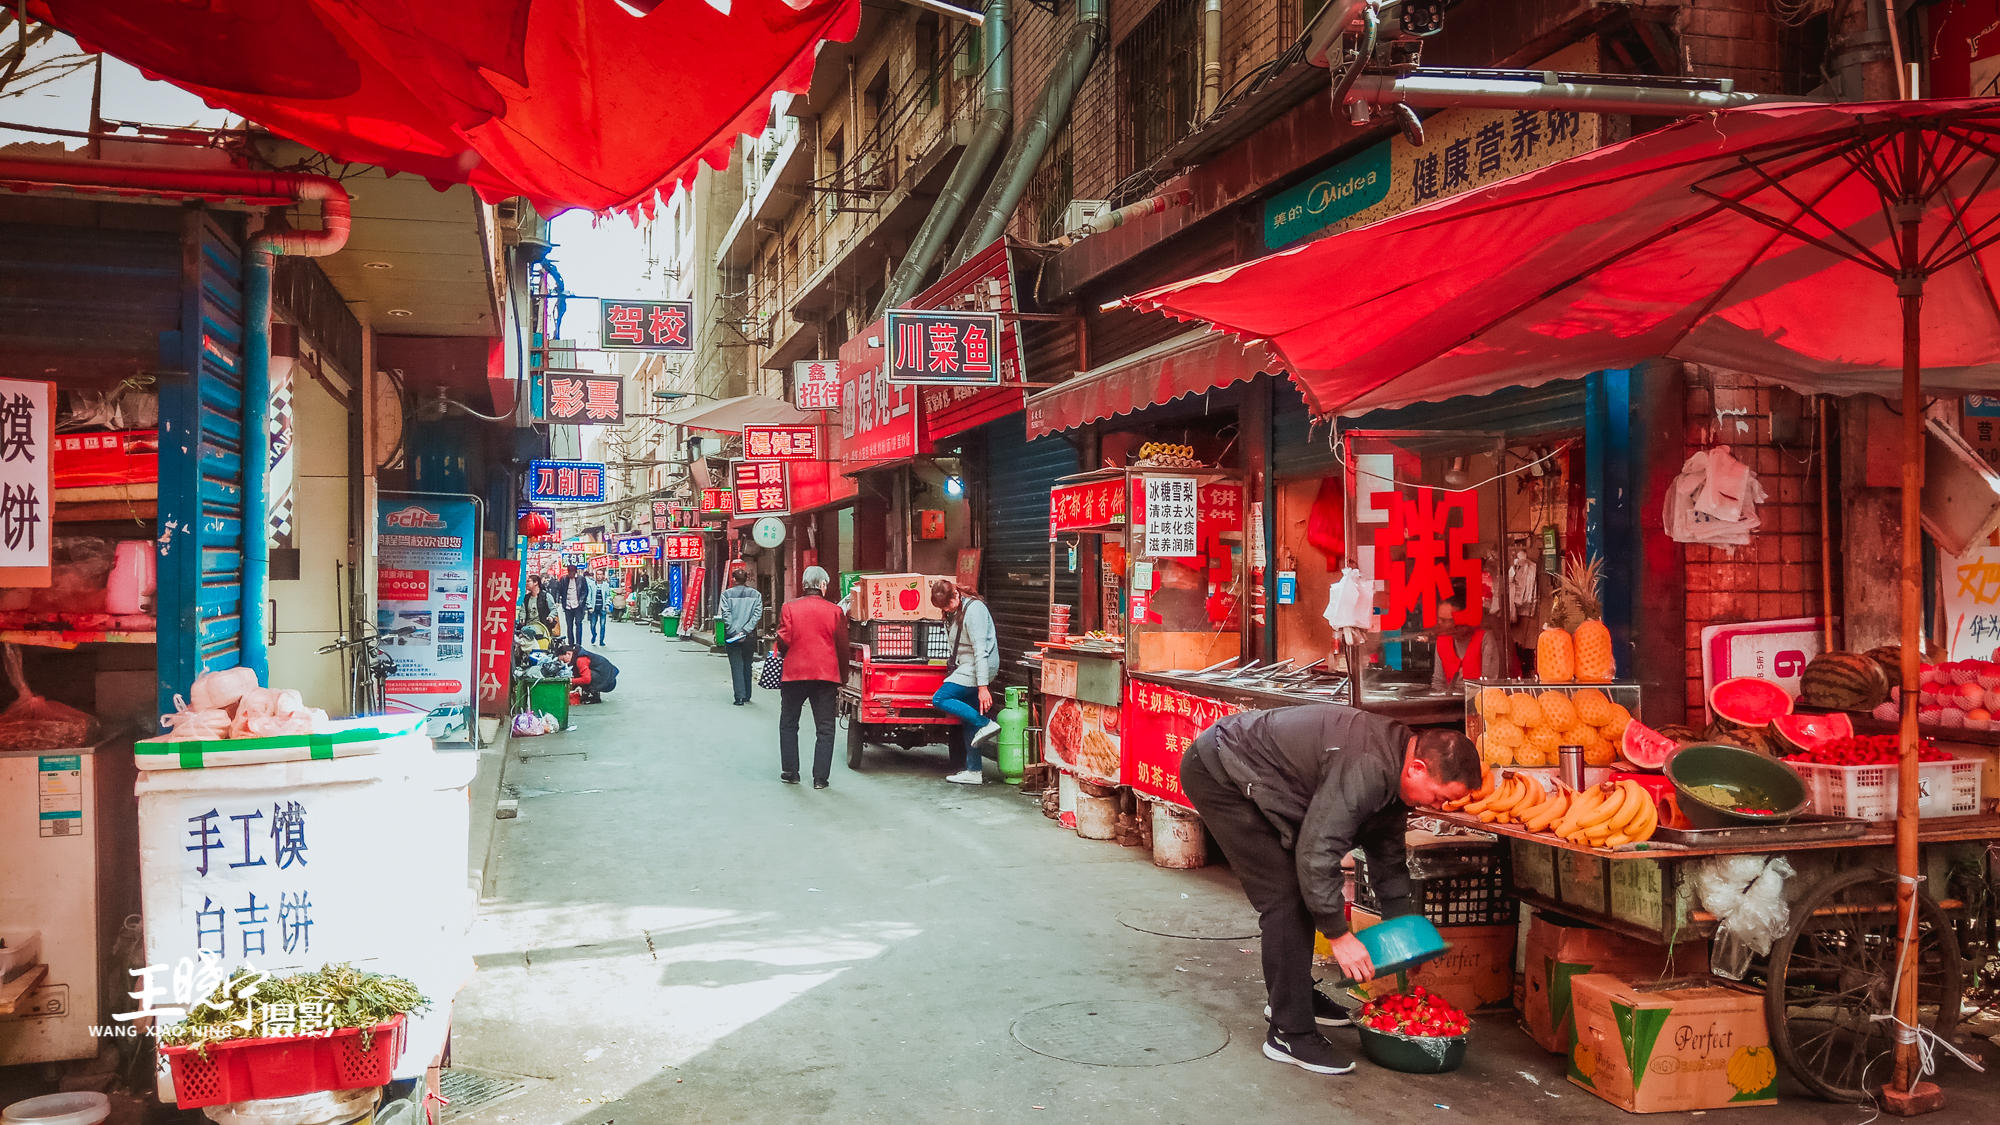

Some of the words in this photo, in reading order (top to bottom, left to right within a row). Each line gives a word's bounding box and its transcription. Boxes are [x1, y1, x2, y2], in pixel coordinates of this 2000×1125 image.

[1411, 108, 1580, 204] 健康营养粥
[1319, 170, 1378, 206] Midea
[1273, 203, 1304, 230] 美的
[608, 304, 687, 345] 驾校
[895, 322, 992, 374] 川菜鱼
[550, 378, 620, 420] 彩票
[749, 431, 813, 456] 馄饨王
[536, 467, 601, 498] 刀削面
[736, 463, 783, 485] 三顾
[1149, 481, 1194, 503] 冰糖雪梨
[738, 487, 783, 510] 冒菜
[1149, 504, 1195, 518] 清凉去火
[0, 482, 41, 553] 饼
[387, 512, 424, 528] PCH
[1149, 521, 1195, 536] 止咳化痰
[1149, 538, 1195, 553] 滋养润肺
[1370, 486, 1483, 632] 粥
[480, 571, 513, 702] 快乐十分
[186, 801, 309, 877] 手工馍
[195, 890, 314, 962] 白吉饼
[1674, 1022, 1733, 1059] Perfect
